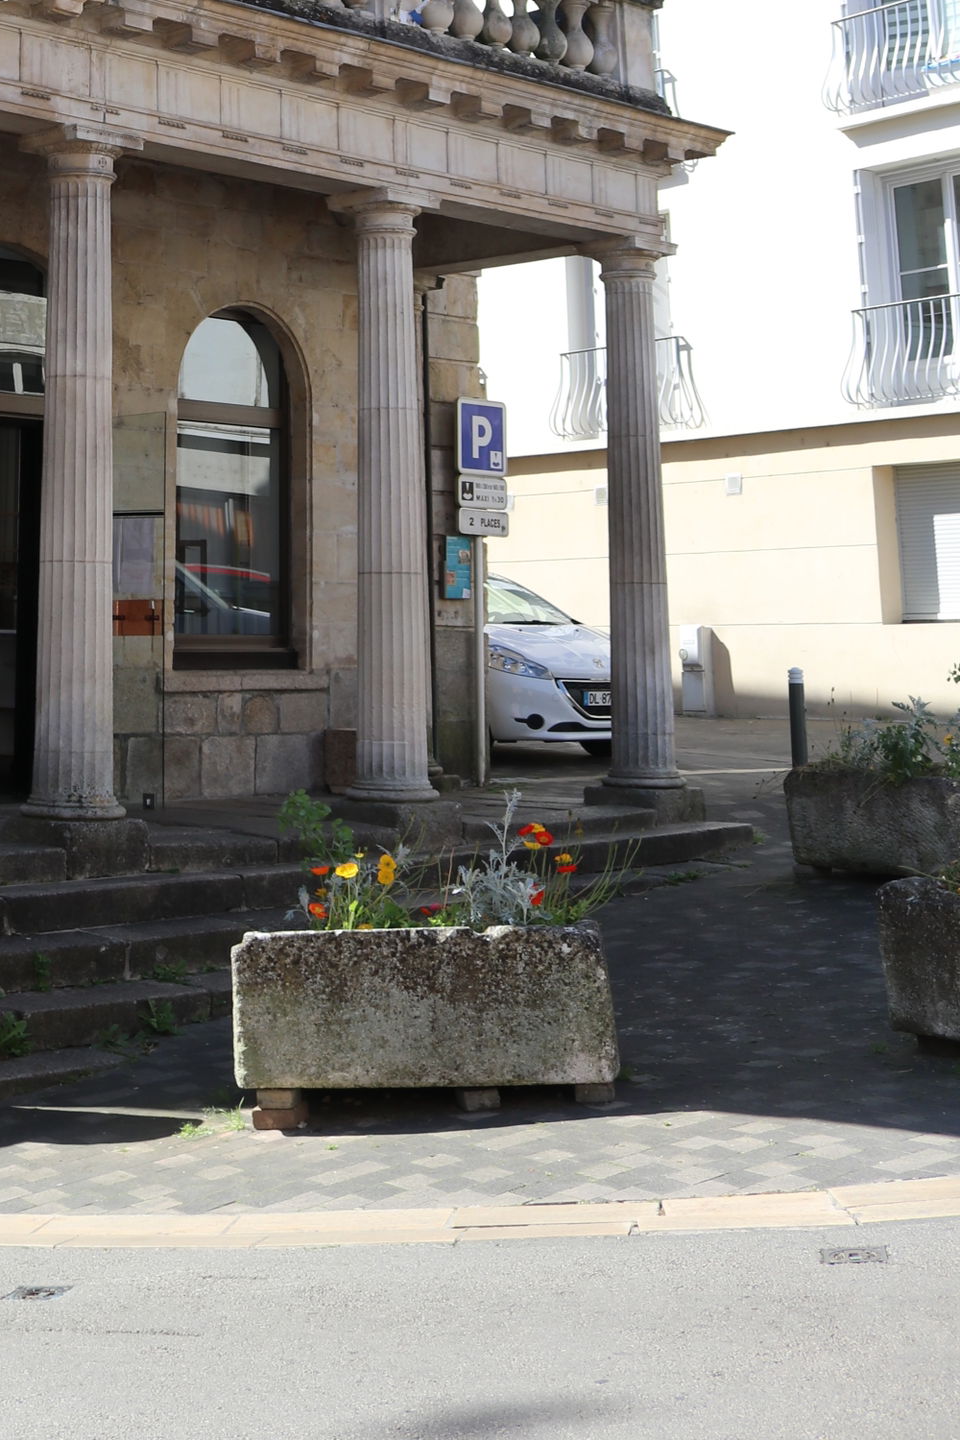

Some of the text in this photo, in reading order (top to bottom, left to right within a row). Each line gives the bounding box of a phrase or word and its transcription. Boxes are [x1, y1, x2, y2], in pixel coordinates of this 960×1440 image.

[472, 415, 492, 458] P
[469, 516, 500, 528] 2 PLACES
